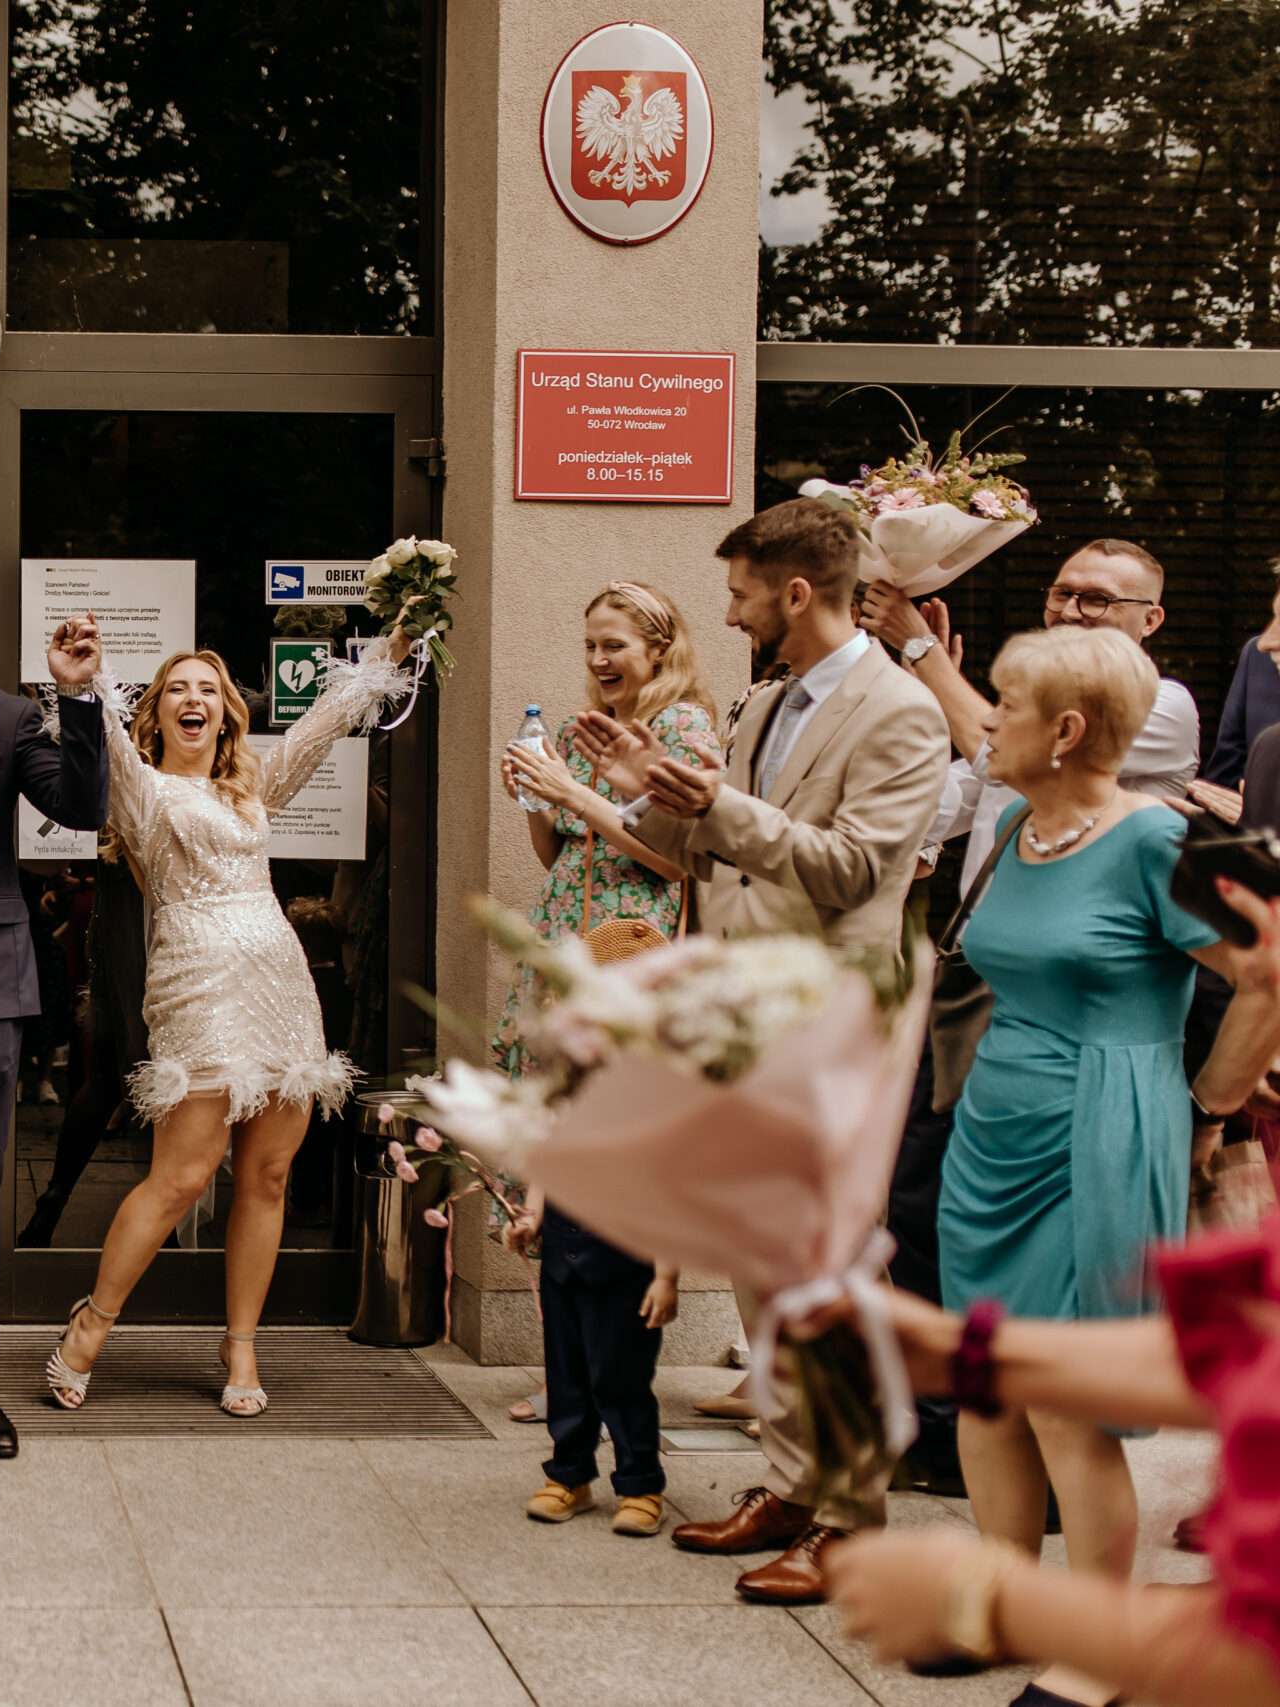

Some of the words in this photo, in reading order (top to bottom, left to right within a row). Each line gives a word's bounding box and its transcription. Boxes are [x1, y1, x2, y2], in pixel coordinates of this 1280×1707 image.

[531, 372, 580, 391] Urząd
[585, 372, 634, 389] Stanu
[638, 373, 724, 393] Cywilnego
[566, 405, 579, 415] ul.
[581, 405, 612, 415] Pawła
[614, 405, 672, 416] Włodkowica
[674, 406, 687, 416] 20
[587, 420, 622, 429] 50-072
[624, 420, 666, 430] Wrocław
[325, 570, 366, 582] OBIEKT
[34, 845, 50, 855] Pętla
[50, 845, 83, 855] indukcyjna
